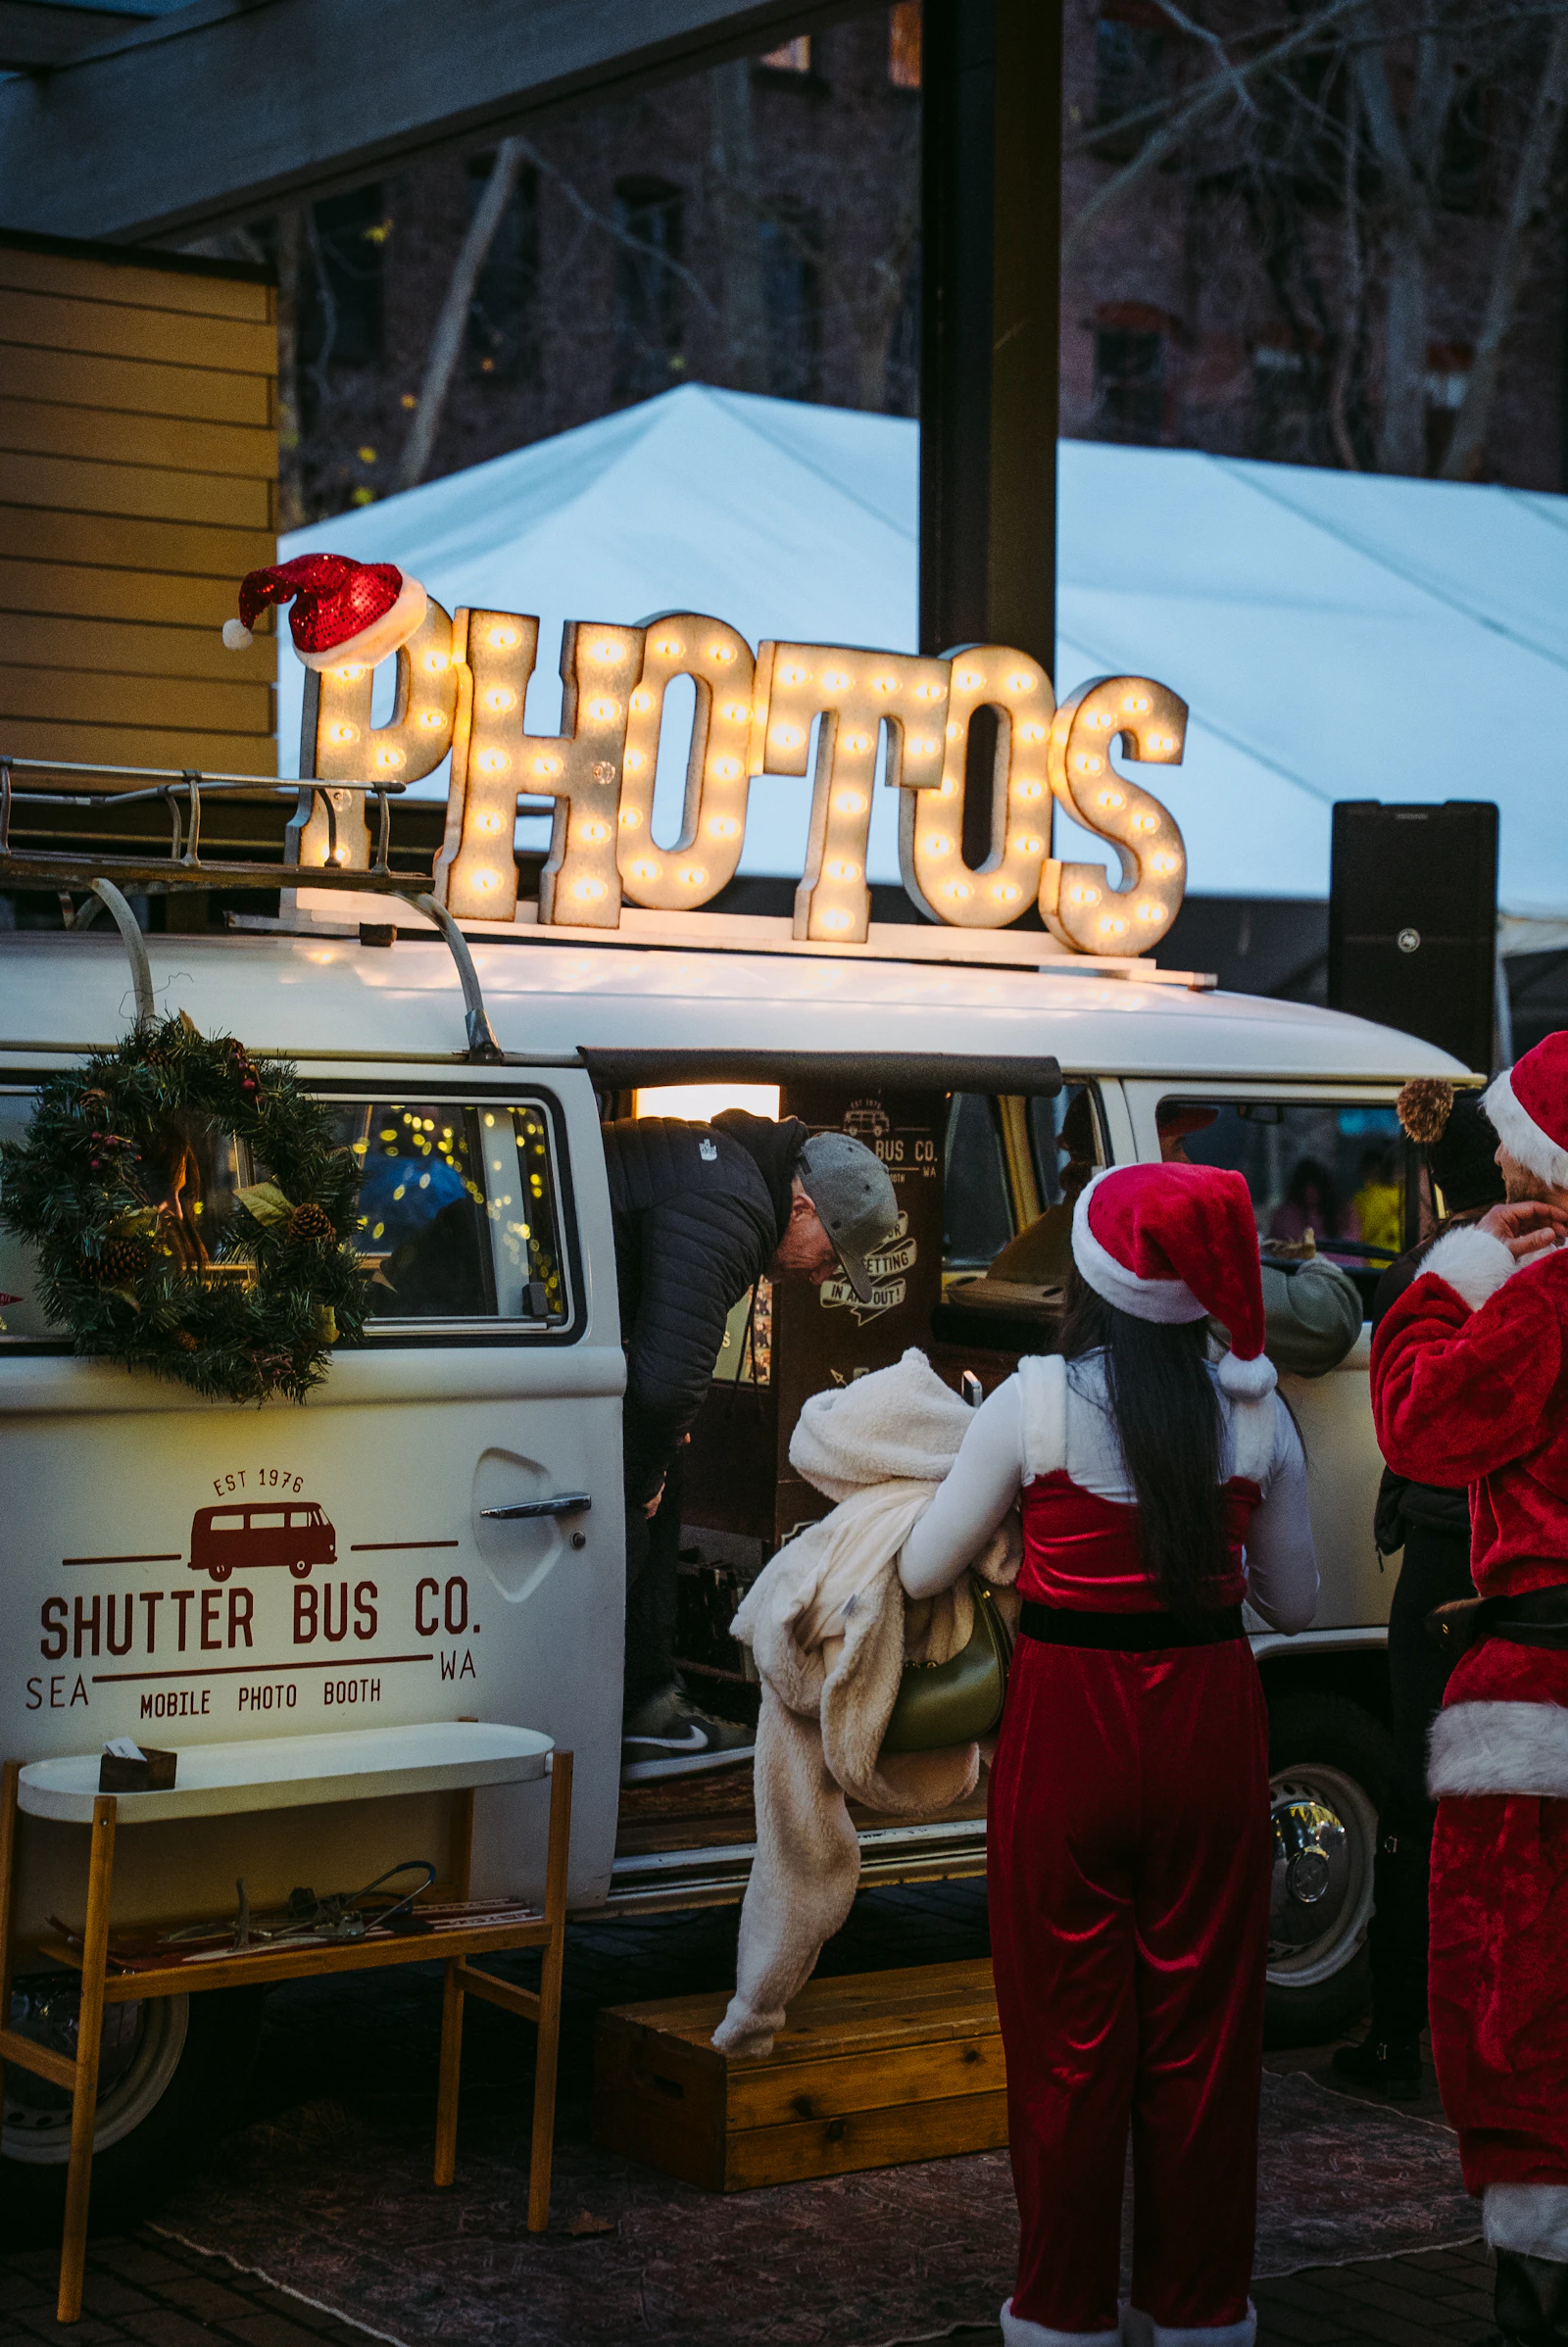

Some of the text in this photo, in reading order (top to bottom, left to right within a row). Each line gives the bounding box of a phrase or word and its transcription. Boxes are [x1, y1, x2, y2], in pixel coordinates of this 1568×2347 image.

[286, 592, 1189, 956] PHOTOS
[875, 1140, 938, 1162] BUS CO.
[923, 1166, 936, 1178] WA
[864, 1252, 909, 1273] ETTING
[831, 1284, 844, 1299] IN
[873, 1287, 901, 1304] OUT!
[213, 1468, 305, 1497] EST 1976
[40, 1575, 481, 1660] SHUTTER BUS CO.
[440, 1647, 477, 1681] WA
[24, 1673, 90, 1710] SEA
[140, 1678, 381, 1719] MOBILE PHOTO BOOTH
